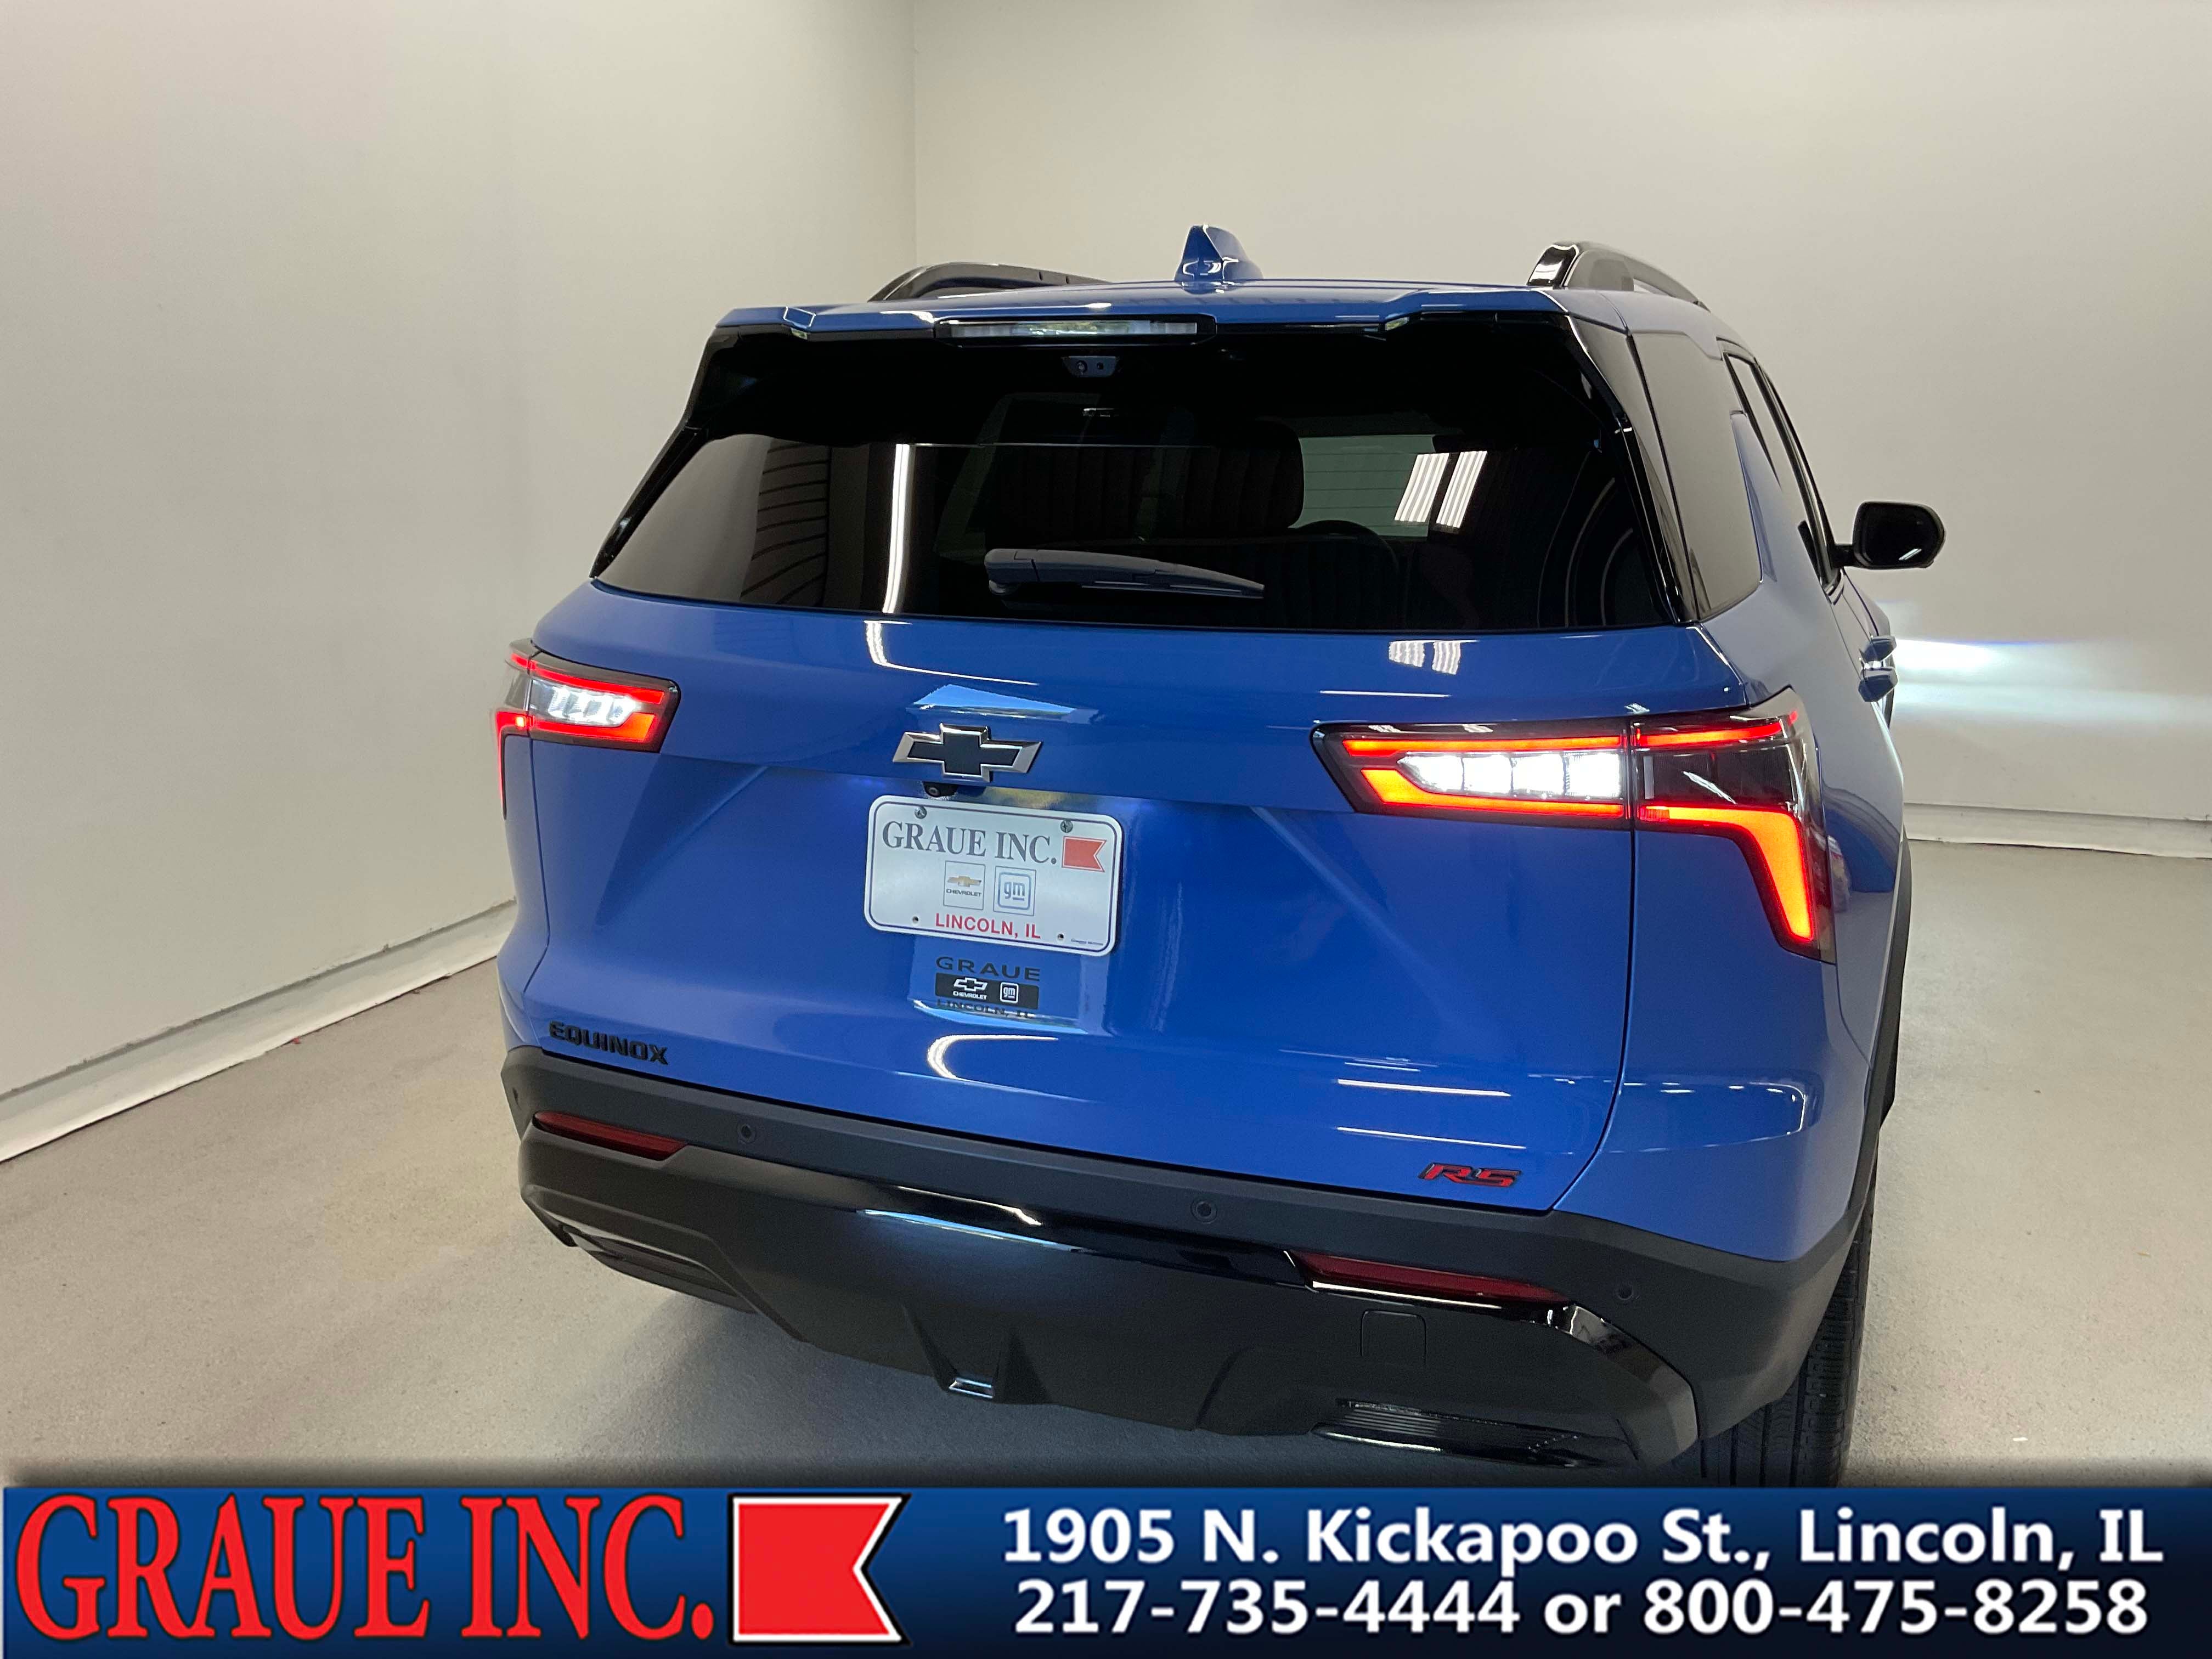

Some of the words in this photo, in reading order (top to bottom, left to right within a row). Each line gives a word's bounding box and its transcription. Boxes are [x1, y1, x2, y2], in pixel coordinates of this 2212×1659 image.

[882, 821, 986, 857] GRAUE
[994, 831, 1057, 865] INC.
[946, 888, 982, 897] CHEVROLET
[1004, 881, 1025, 901] gm
[935, 912, 1018, 939] LINCOLN,
[1025, 923, 1041, 939] IL
[936, 956, 1041, 981] GRAUE
[952, 991, 988, 1000] CHEVROLET
[1003, 986, 1015, 999] gm
[550, 1020, 669, 1065] EQUINOX
[1418, 1162, 1521, 1187] RS
